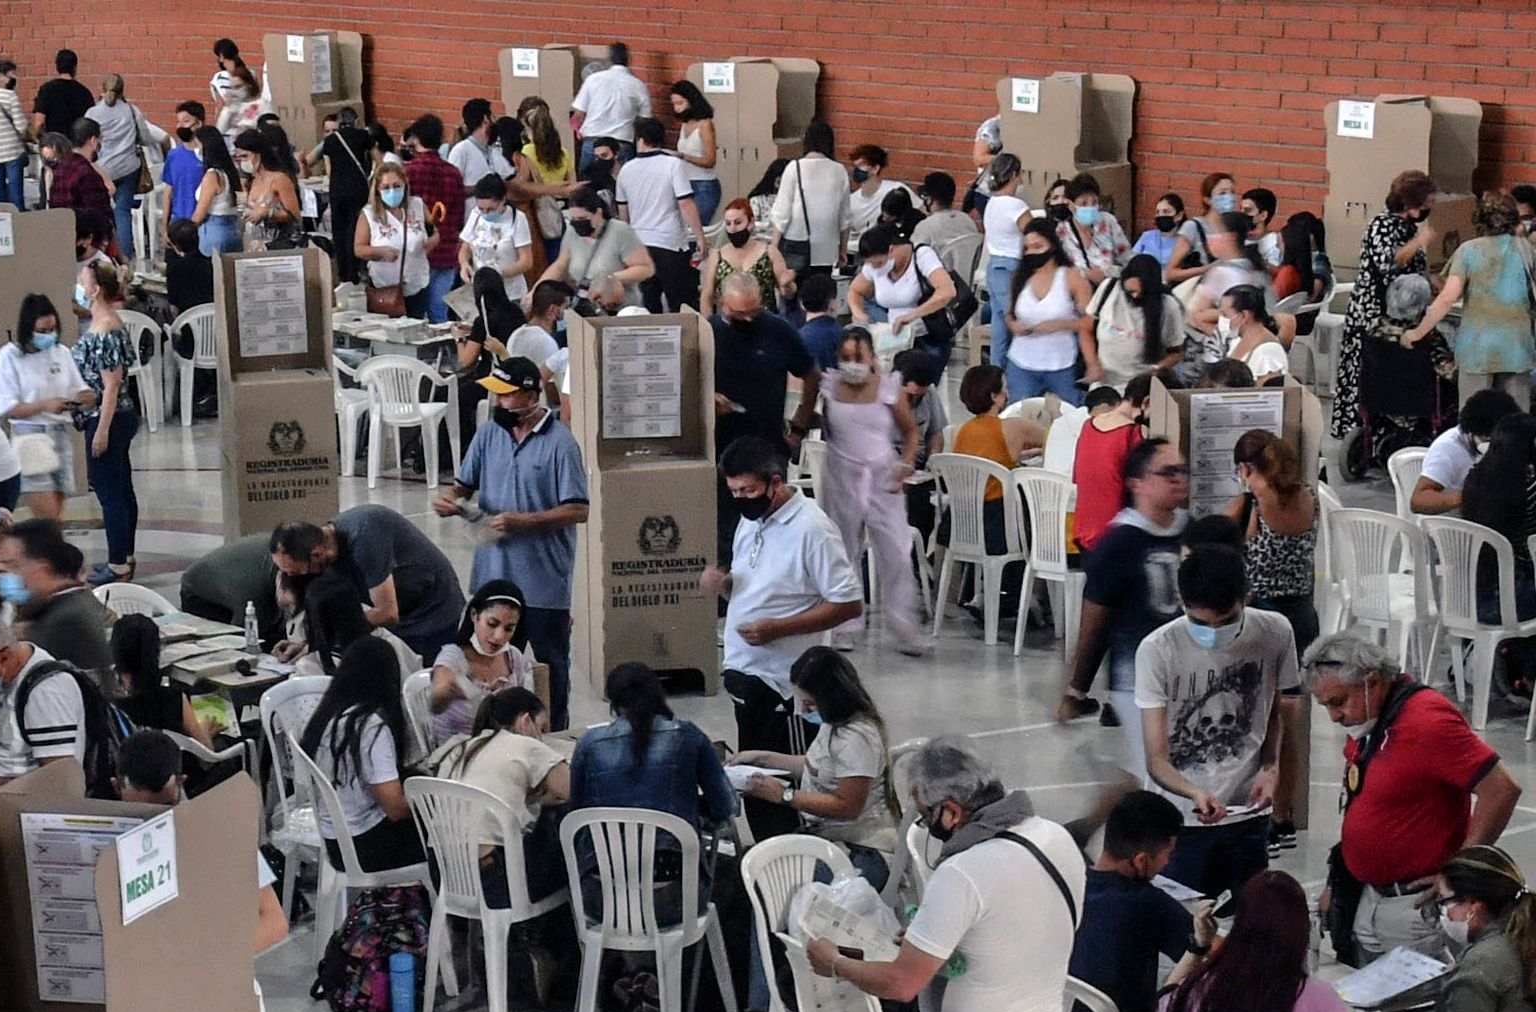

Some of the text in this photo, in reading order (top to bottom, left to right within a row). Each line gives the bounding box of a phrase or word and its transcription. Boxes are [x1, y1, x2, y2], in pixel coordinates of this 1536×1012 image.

[1343, 119, 1362, 129] MESA
[126, 861, 171, 903] MESA 21
